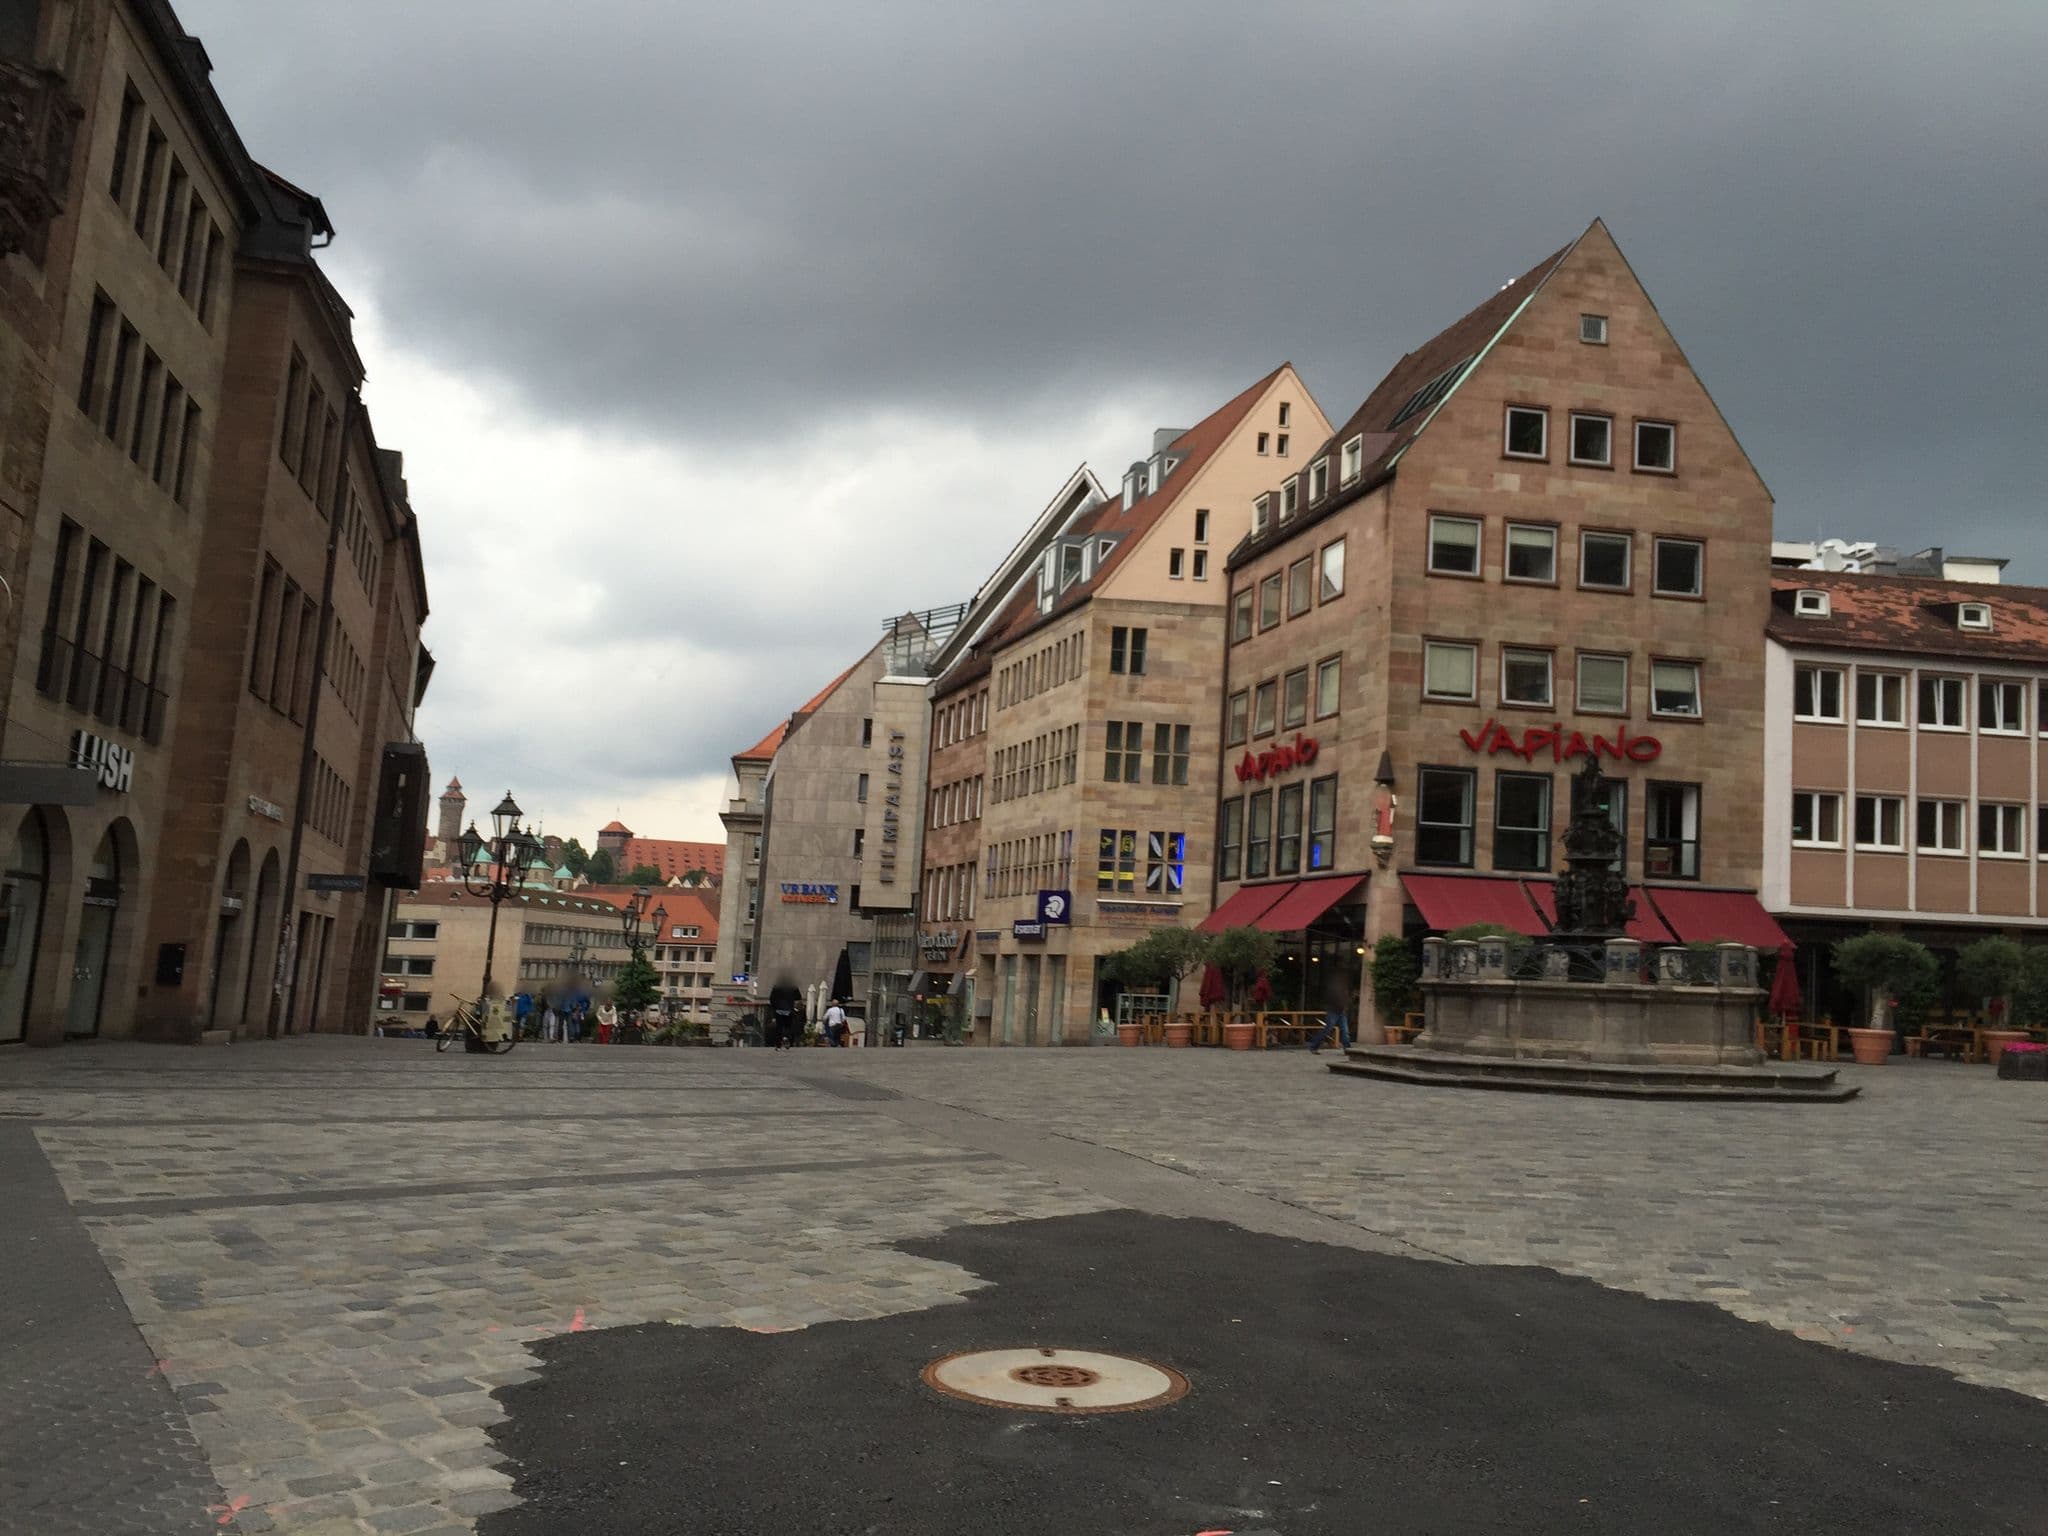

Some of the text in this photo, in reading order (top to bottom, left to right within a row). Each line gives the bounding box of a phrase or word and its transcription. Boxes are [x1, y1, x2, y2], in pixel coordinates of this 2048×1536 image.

[77, 730, 135, 793] LUSH
[781, 883, 838, 896] VR BANK
